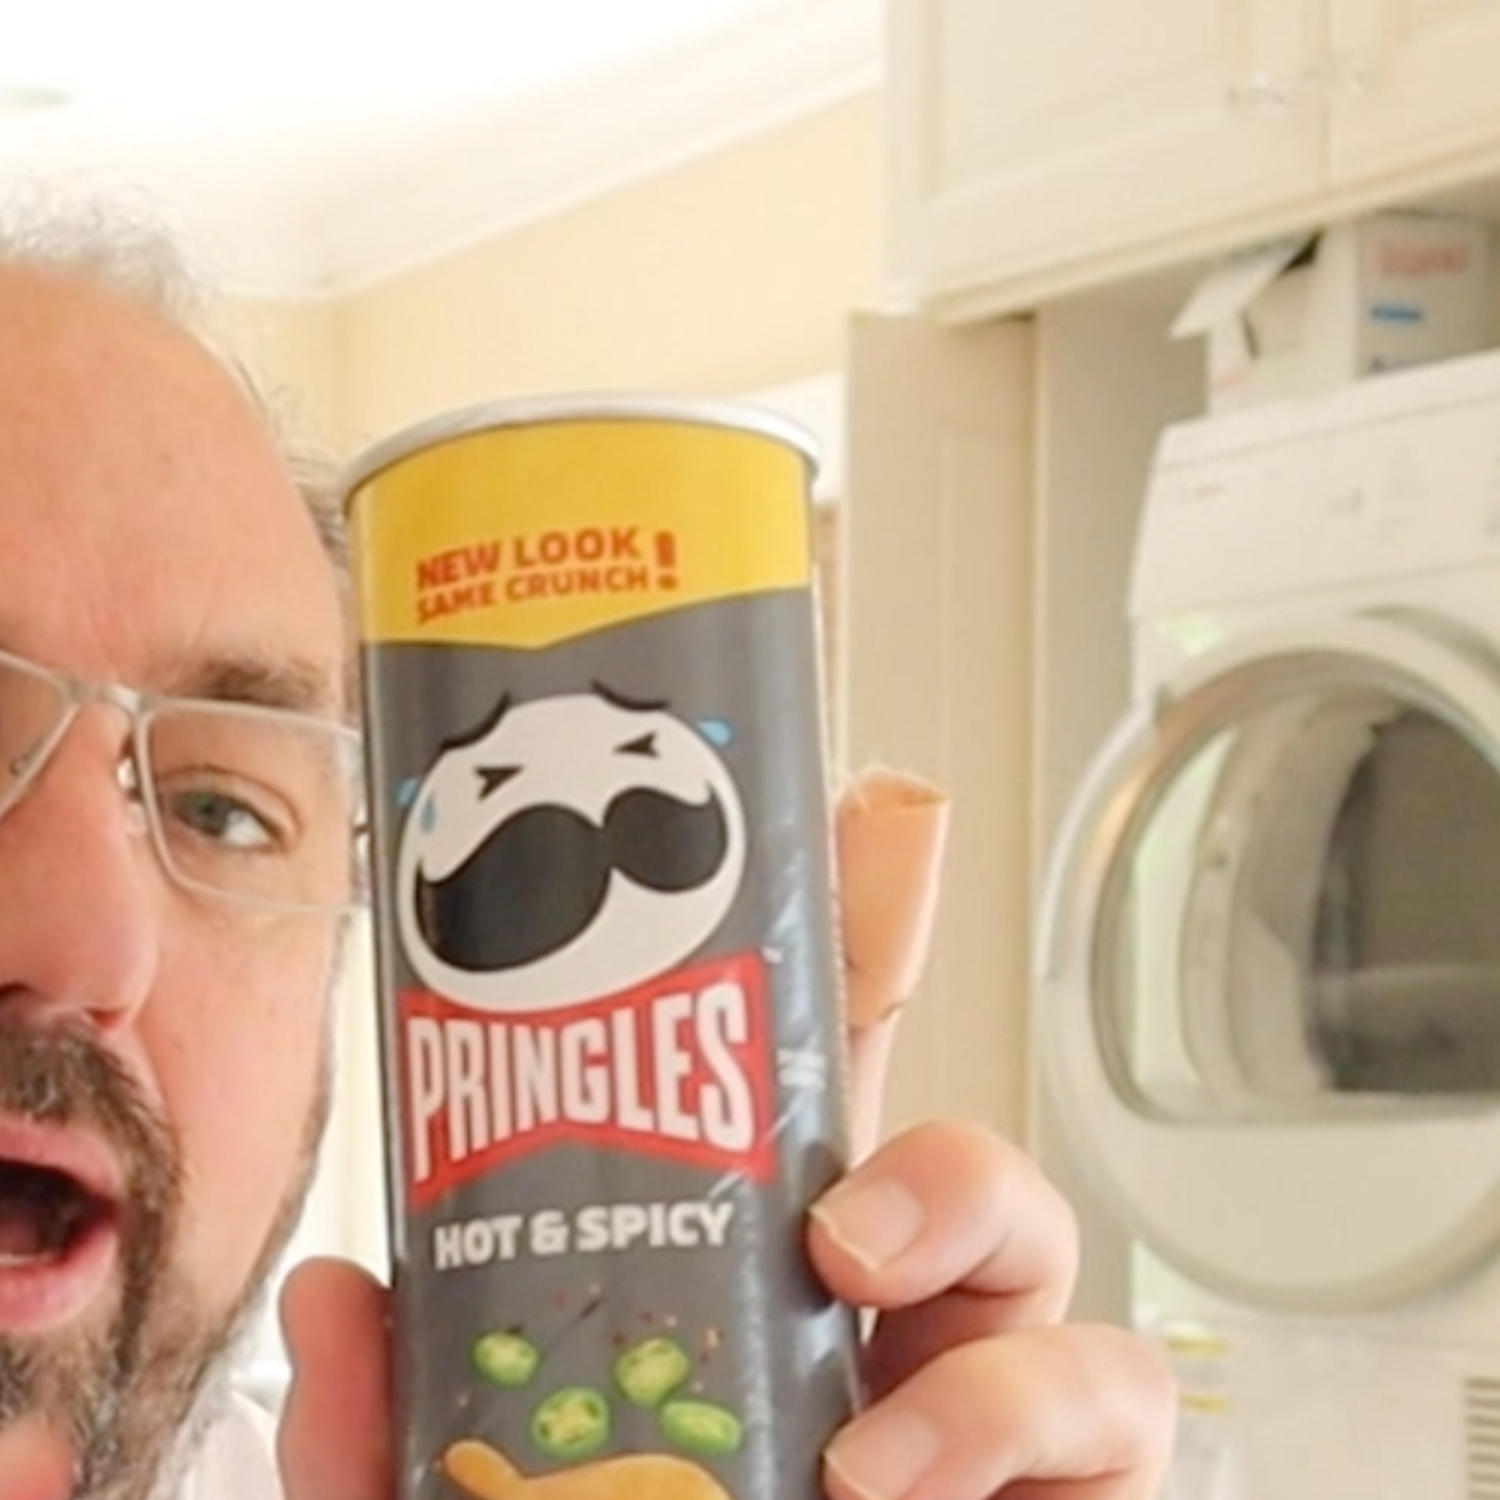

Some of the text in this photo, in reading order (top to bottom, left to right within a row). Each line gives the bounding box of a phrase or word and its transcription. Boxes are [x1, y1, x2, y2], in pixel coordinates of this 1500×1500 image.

[416, 527, 639, 591] NEW LOOK
[417, 581, 496, 626] SAME
[406, 981, 756, 1184] PRINGLES
[434, 1202, 735, 1271] HOT & SPICY
